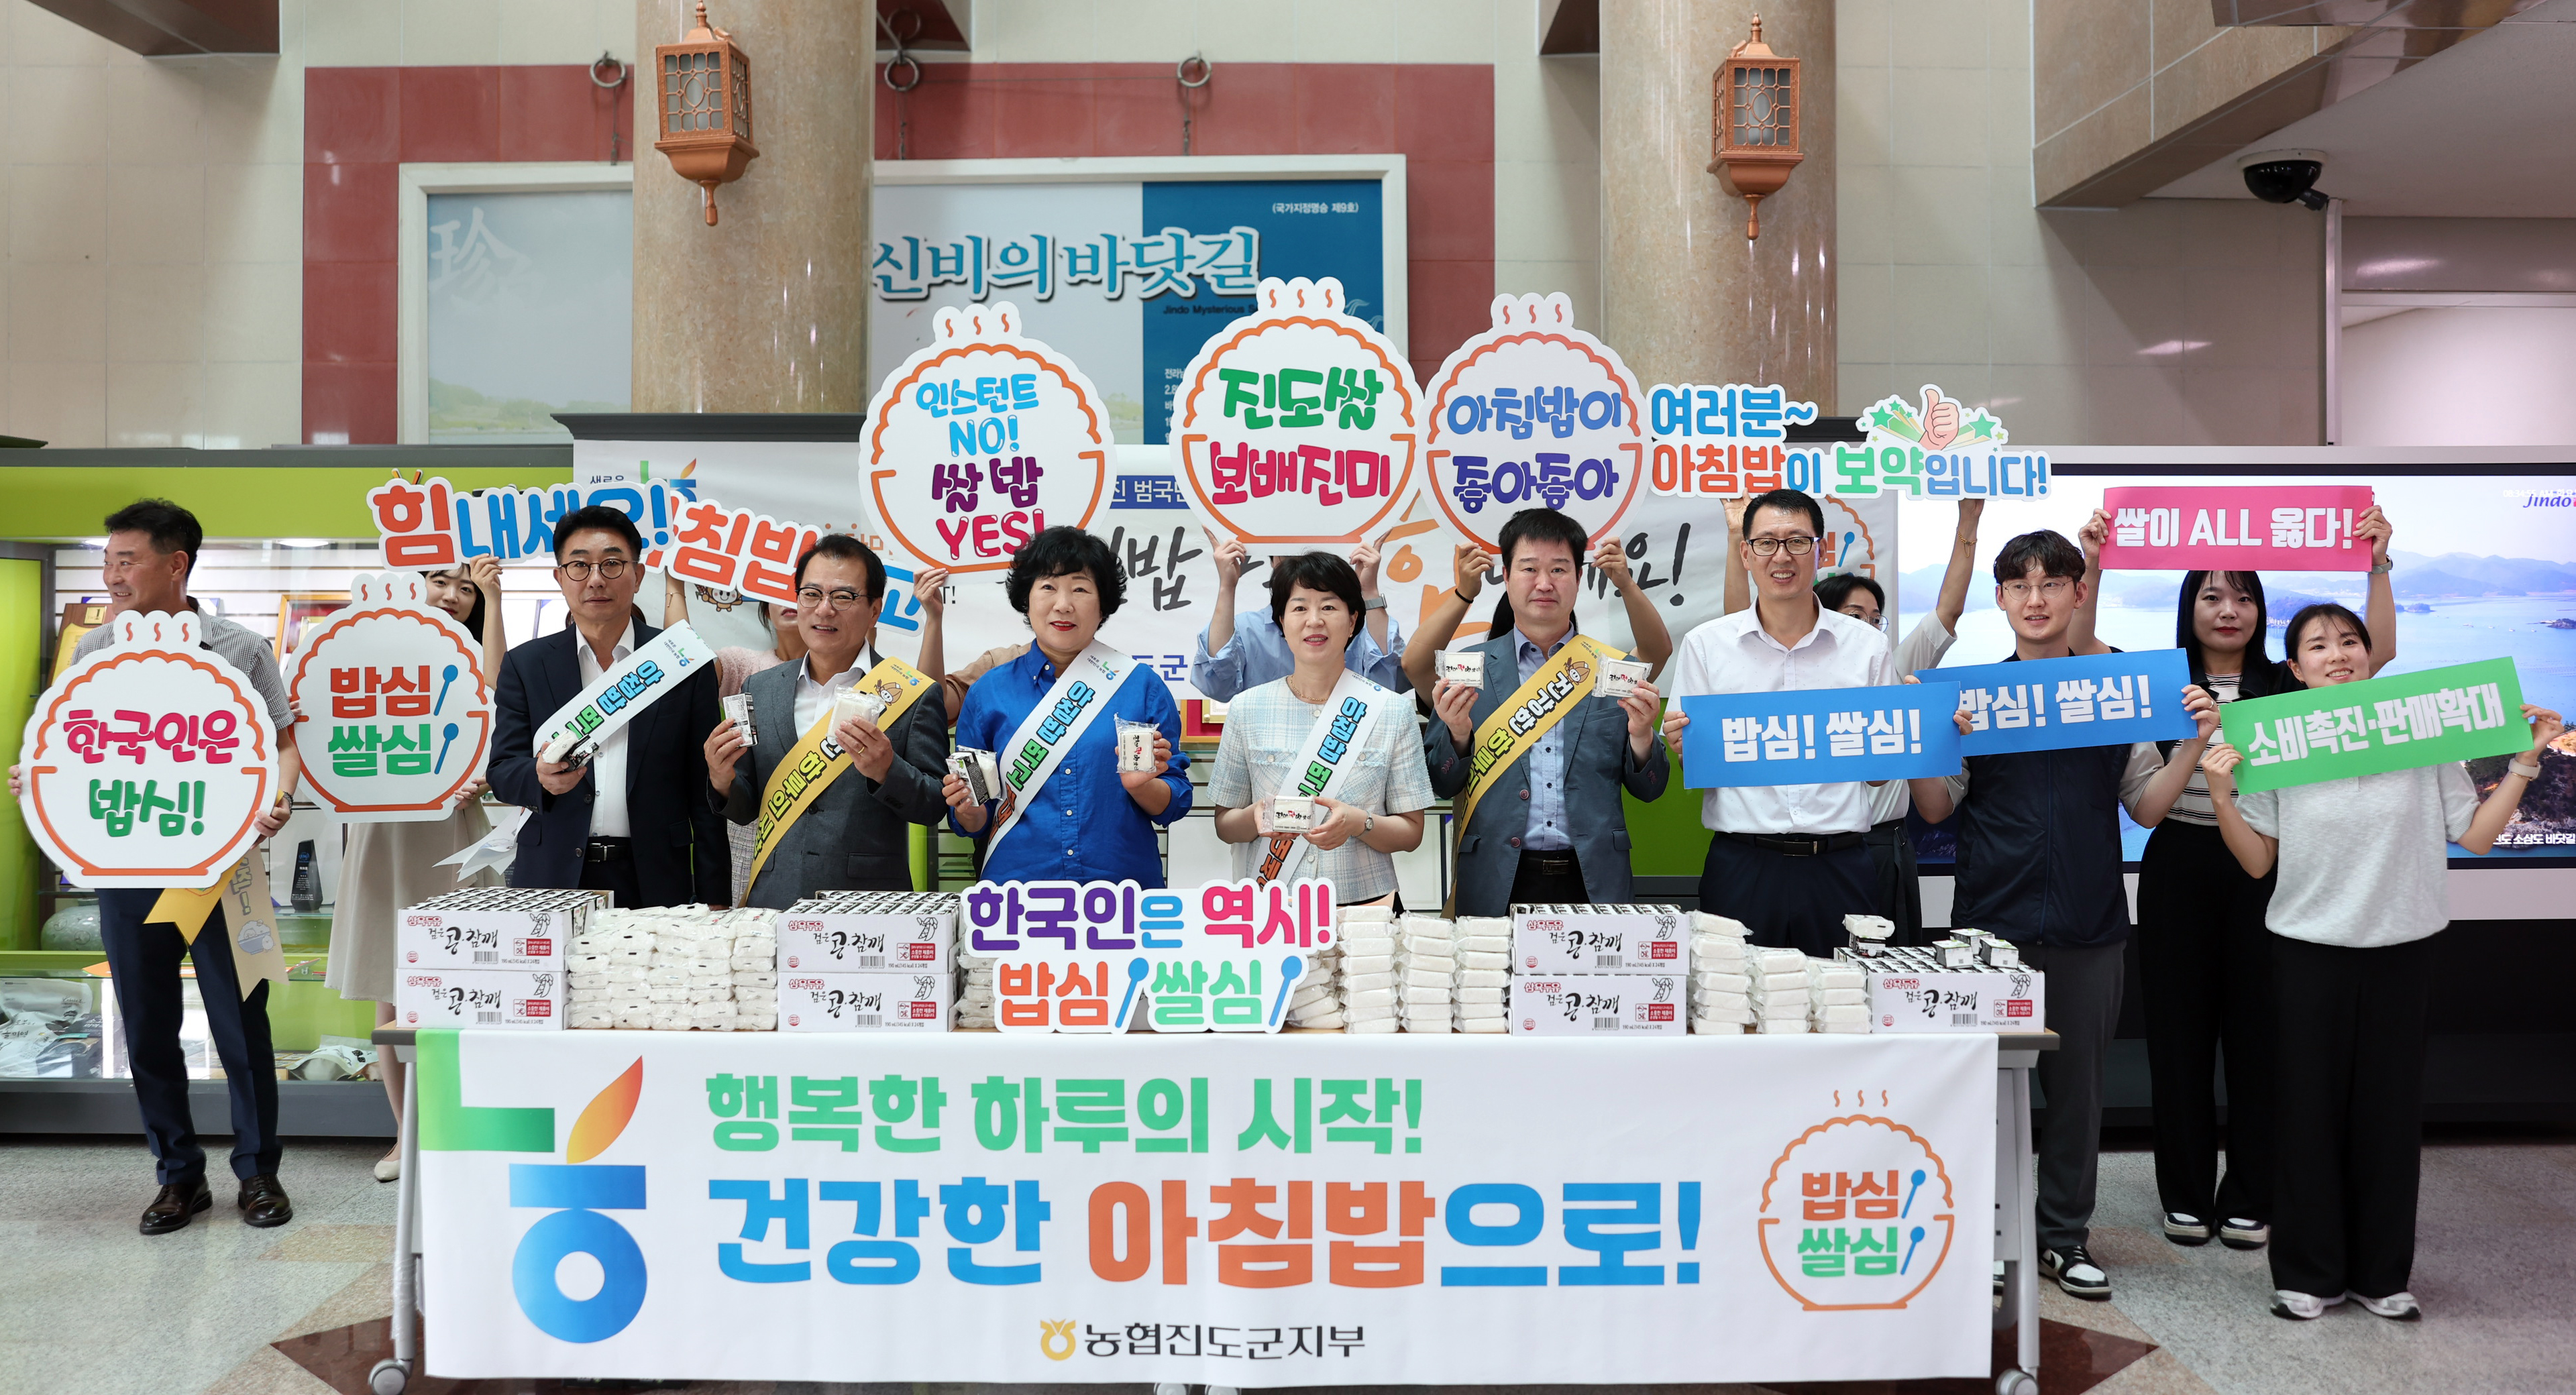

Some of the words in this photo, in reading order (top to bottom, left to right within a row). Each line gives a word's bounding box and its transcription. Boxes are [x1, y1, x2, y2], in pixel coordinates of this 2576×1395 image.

[1272, 202, 1328, 213] (국가지정명승
[1332, 202, 1359, 213] 제9호)
[1163, 304, 1189, 314] Jindo
[1192, 304, 1245, 316] Mysterious
[916, 373, 1039, 418] 인스턴트
[1219, 366, 1383, 431] 진도쌀
[1447, 386, 1622, 440] 아침밥이
[1652, 388, 1813, 438] 여러분~
[949, 414, 1020, 457] NO!
[1210, 441, 1391, 506] 보배진미
[1452, 452, 1619, 514] 좋아좋아
[1652, 443, 1821, 494] 아침밥이
[1835, 445, 2047, 497] 보약입니다!
[936, 508, 1044, 561] YES!
[2114, 507, 2180, 549] 쌀이
[2188, 507, 2263, 547] ALL
[2270, 506, 2354, 549] 옳다!
[330, 665, 432, 720] 밥심
[596, 660, 665, 716] 아침밥
[1036, 680, 1096, 746] 아침밥
[1508, 671, 1574, 738] 건강한
[1959, 683, 2046, 732] 밥심!
[2054, 673, 2152, 724] 쌀심!
[63, 709, 241, 765] 한국인은
[327, 723, 431, 778] 쌀심
[1317, 695, 1368, 765] 아침밥
[1721, 714, 1816, 763] 밥심!
[1825, 708, 1923, 759] 쌀심!
[2247, 682, 2506, 767] 소비촉진·판매확대
[767, 750, 827, 823] 하루의
[1006, 738, 1049, 792] 먹고
[89, 778, 206, 838] 밥심!
[2545, 834, 2576, 845] 바닷길
[407, 915, 443, 927] 삼육두유
[428, 928, 444, 940] 검은
[788, 920, 824, 932] 삼육두유
[813, 932, 829, 945] 검은
[967, 886, 1184, 951] 한국인은
[1202, 883, 1330, 949] 역시!
[1526, 919, 1564, 931] 삼육두유
[1549, 932, 1566, 944] 검은
[407, 976, 443, 987] 삼육두유
[431, 989, 447, 1001] 검은
[788, 979, 824, 990] 삼육두유
[810, 991, 827, 1003] 검은
[1000, 961, 1109, 1026] 밥심
[1150, 959, 1263, 1025] 쌀심
[1524, 982, 1561, 993] 삼육두유
[1546, 994, 1563, 1006] 검은
[1882, 979, 1920, 989] 삼육두유
[1905, 991, 1922, 1003] 검은
[705, 1072, 947, 1154] 행복한
[970, 1076, 1209, 1154] 하루의
[1237, 1076, 1423, 1155] 시작!
[1802, 1169, 1899, 1221] 밥심
[708, 1174, 1051, 1286] 건강한
[1087, 1177, 1702, 1289] 아침밥으로!
[1797, 1226, 1898, 1278] 쌀심
[1084, 1321, 1366, 1361] 농협진도군지부
